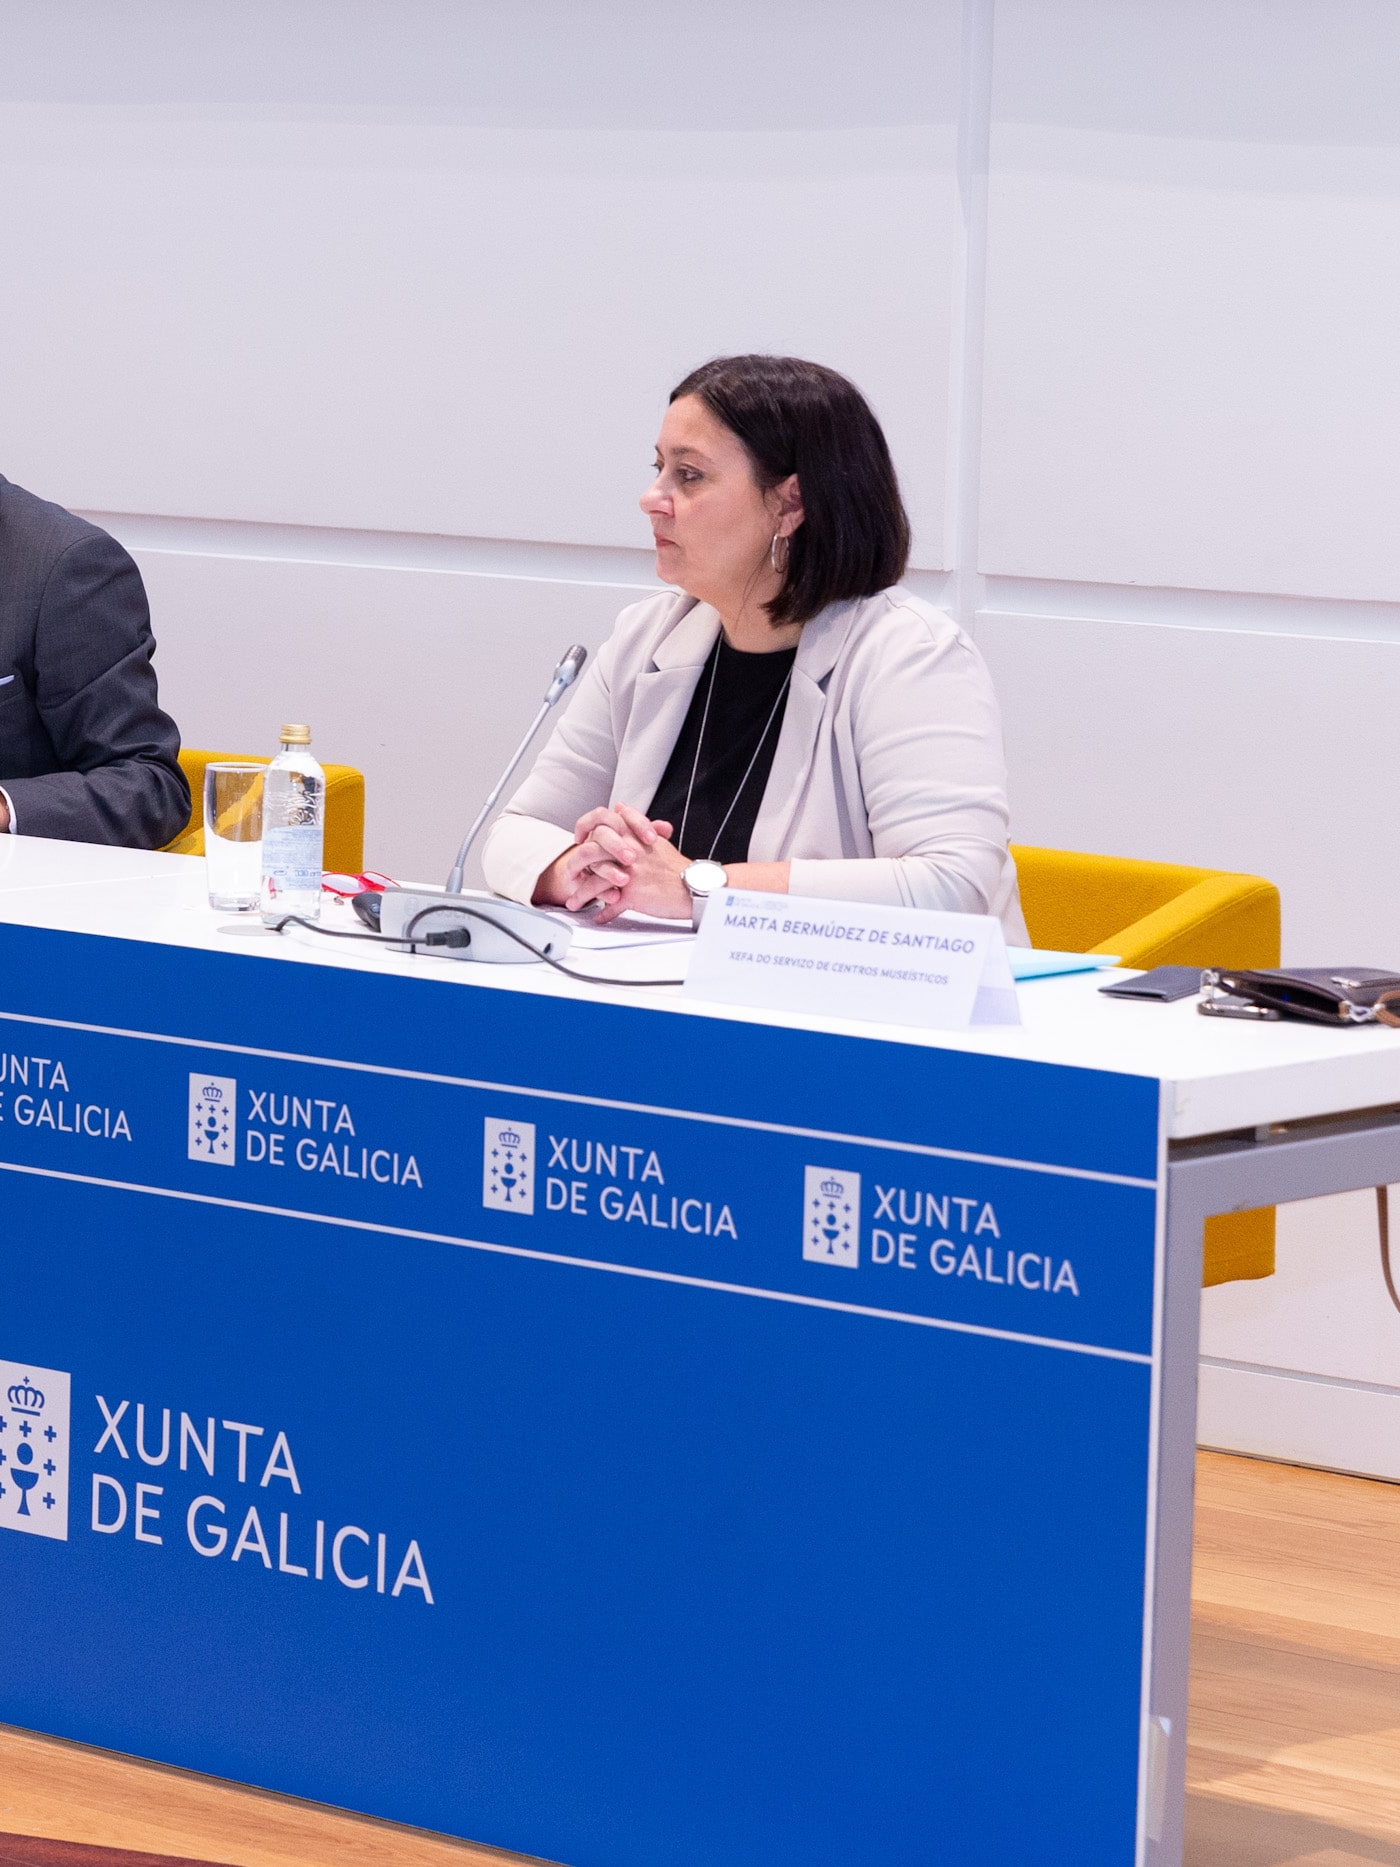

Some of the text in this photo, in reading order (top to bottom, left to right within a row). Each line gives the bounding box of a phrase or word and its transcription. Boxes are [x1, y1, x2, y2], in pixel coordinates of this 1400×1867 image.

[724, 914, 975, 954] MARTA BERMÚDEZ DE SANTIAGO
[729, 951, 949, 985] XEFA DO SERVIZO DE CENTROS MUSEÍSTICOS
[14, 1094, 132, 1141] GALICIA
[248, 1089, 356, 1137] XUNTA
[246, 1129, 423, 1188] DE GALICIA
[548, 1135, 664, 1185] XUNTA
[546, 1177, 738, 1240] DE GALICIA
[873, 1185, 1000, 1238] XUNTA
[871, 1228, 1079, 1296] DE GALICIA
[93, 1395, 302, 1495] XUNTA
[91, 1473, 434, 1605] DE GALICIA
